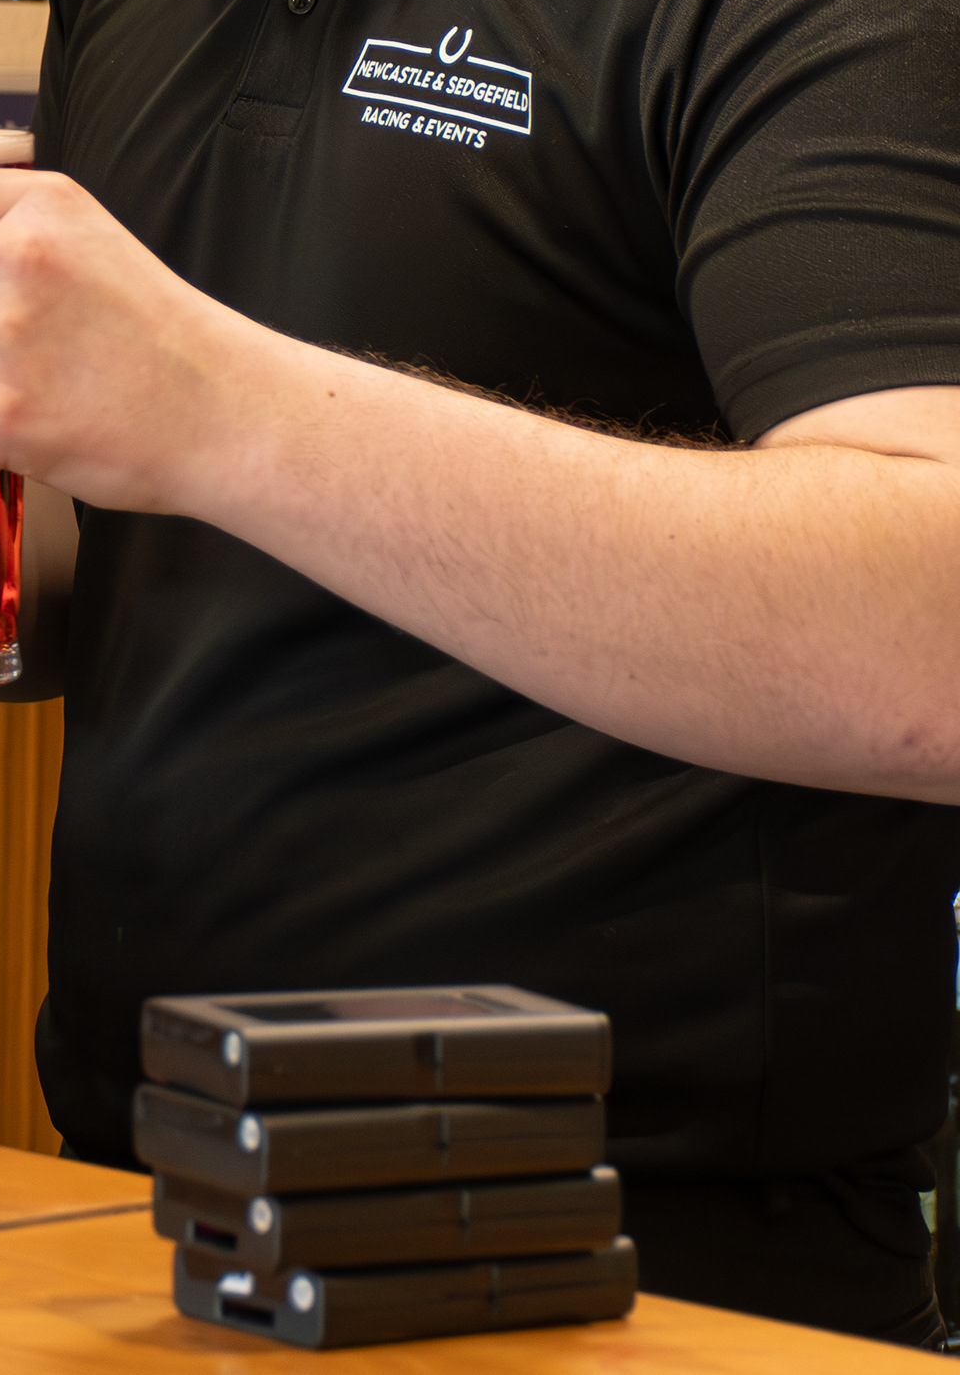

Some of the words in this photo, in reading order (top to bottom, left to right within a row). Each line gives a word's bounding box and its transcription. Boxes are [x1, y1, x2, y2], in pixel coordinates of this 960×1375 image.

[357, 59, 434, 89] NEWCASTLE
[431, 73, 445, 91] &
[446, 76, 528, 112] SEDGEFIELD
[361, 106, 412, 130] RACING
[411, 116, 425, 133] &
[424, 118, 488, 149] EVENTS
